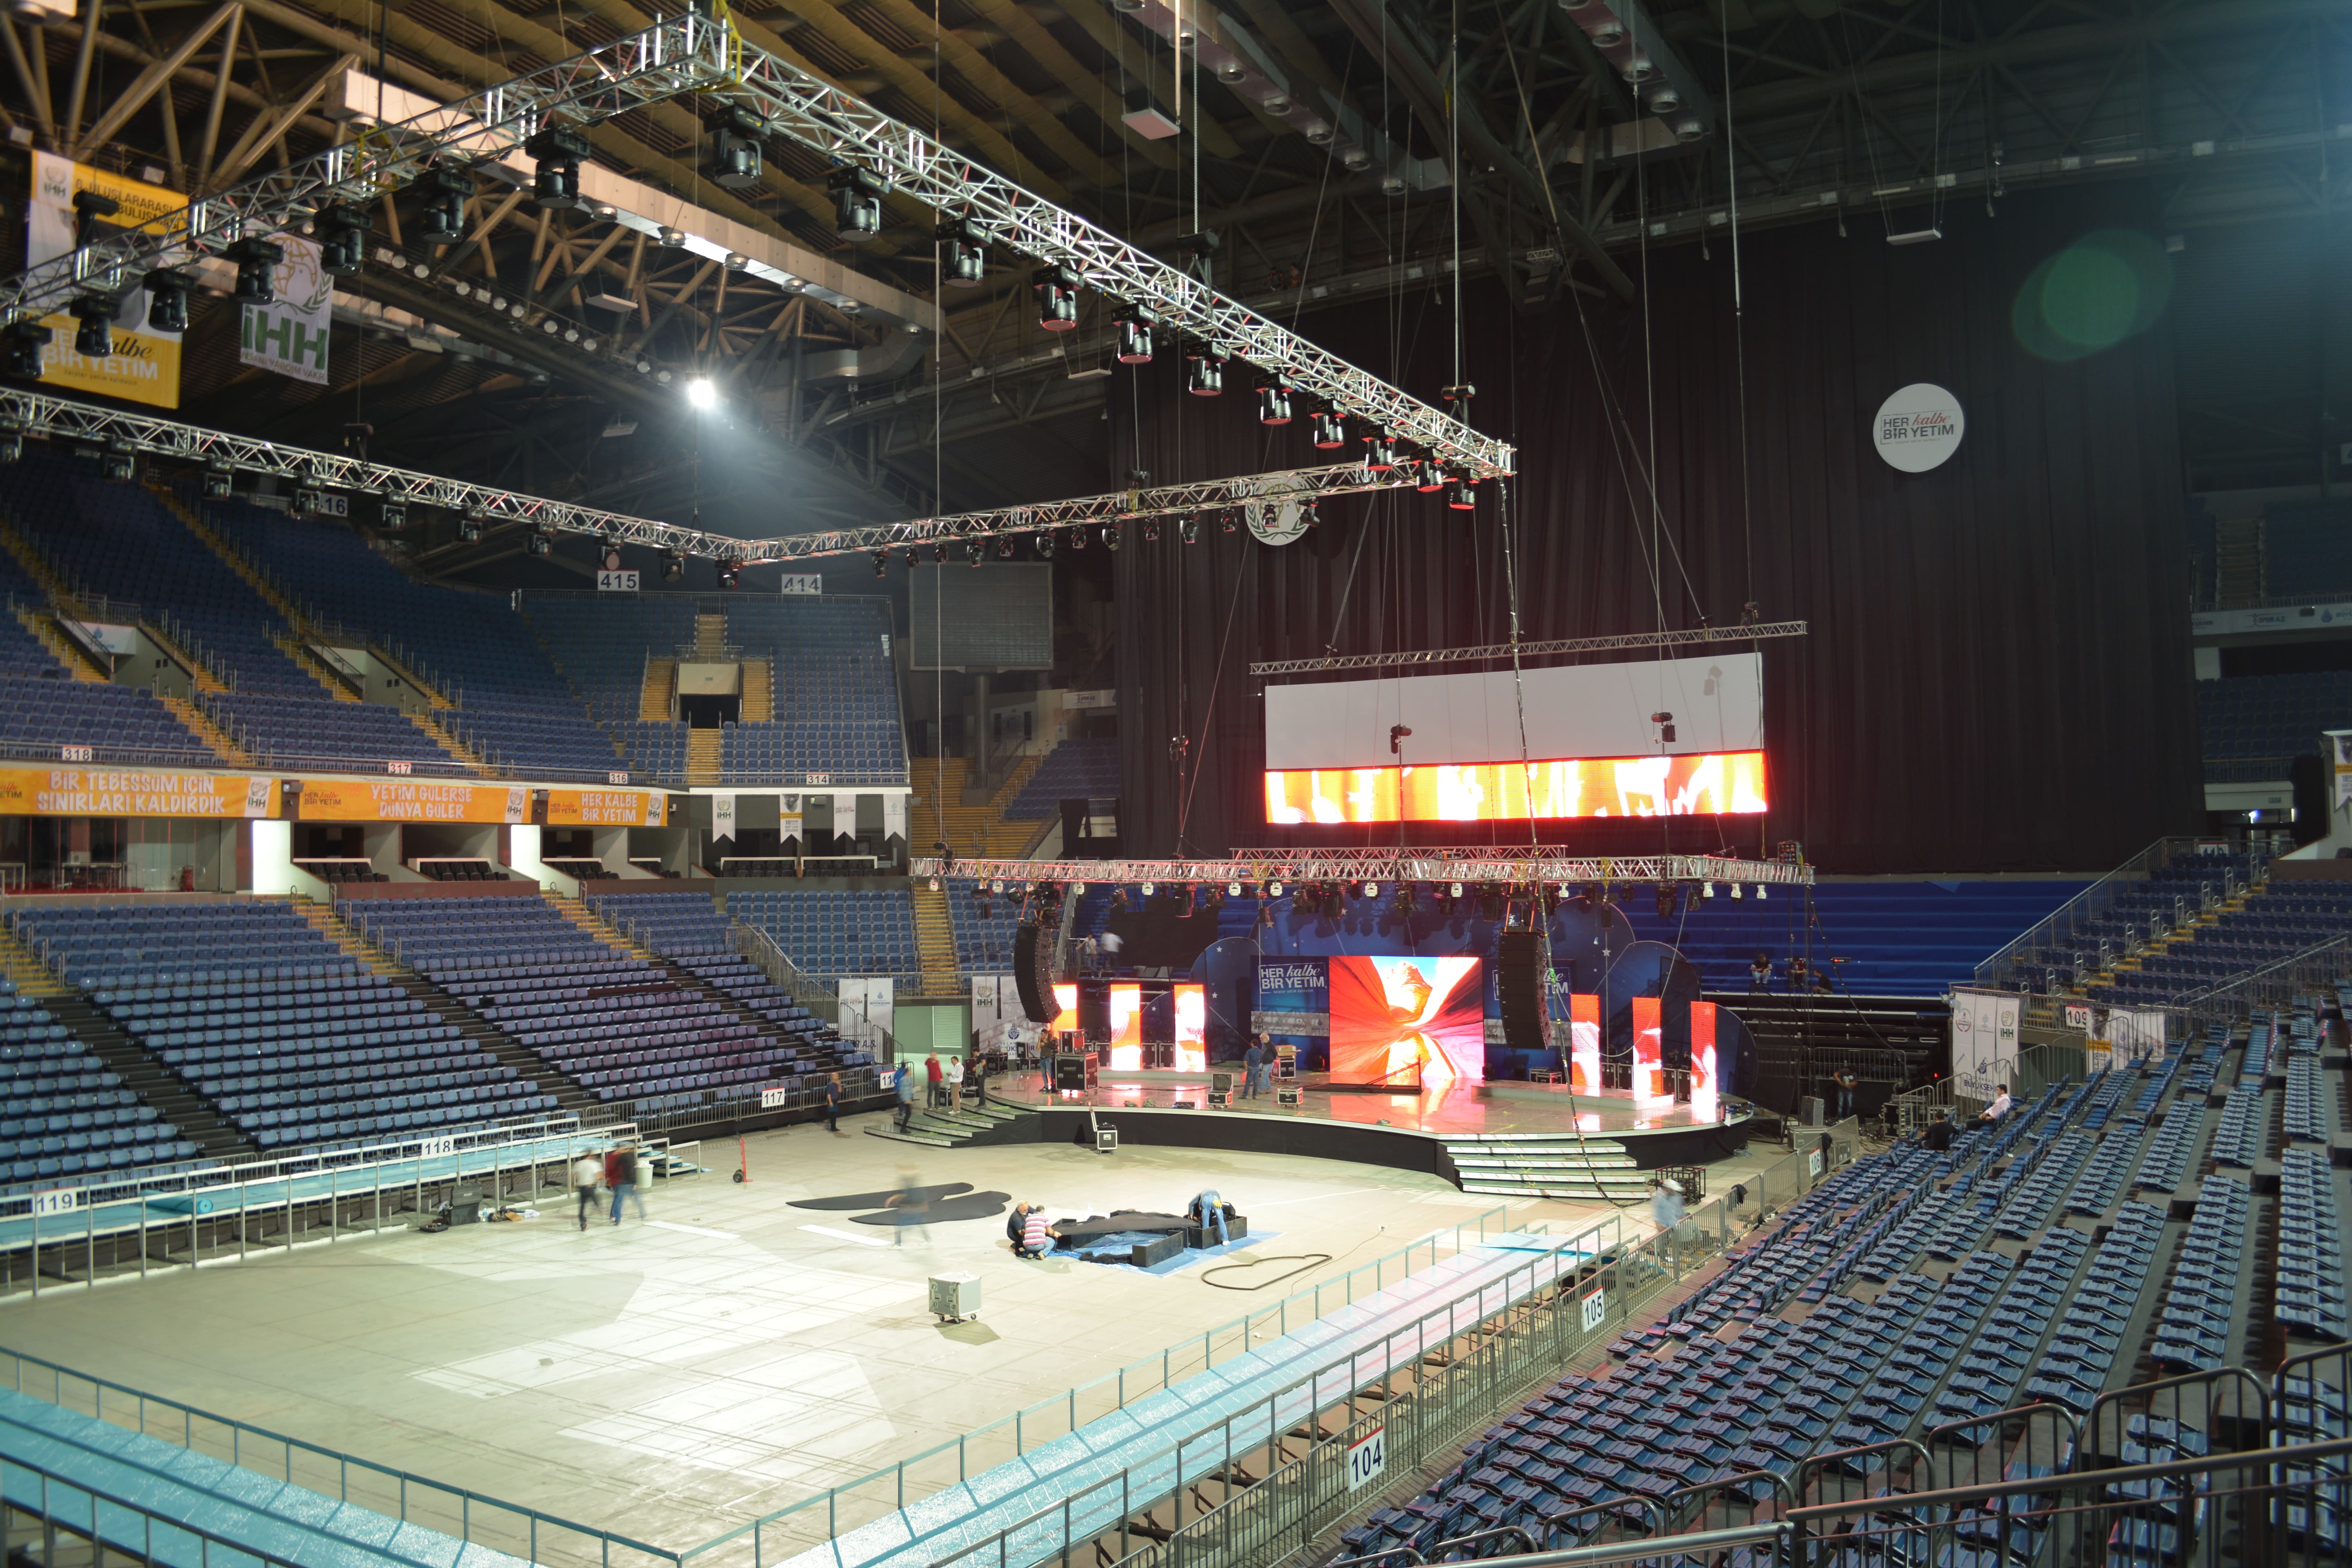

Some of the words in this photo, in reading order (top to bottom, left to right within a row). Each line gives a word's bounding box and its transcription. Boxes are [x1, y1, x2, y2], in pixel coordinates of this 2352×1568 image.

[1883, 417, 1909, 428] HER
[1912, 412, 1951, 426] kalbe
[325, 497, 345, 514] 16
[600, 573, 637, 589] 415
[784, 577, 820, 592] 414
[65, 748, 90, 760] 318
[390, 763, 410, 774] 317
[85, 772, 179, 793] TEBESSÜM
[610, 773, 626, 783] 316
[808, 775, 828, 784] 314
[419, 785, 472, 803] GÜLERSE
[581, 792, 603, 807] HER
[604, 793, 638, 808] KALBE
[37, 791, 131, 812] SINIRLARI
[135, 794, 226, 814] KALDIRDIK
[379, 802, 423, 818] DÜNYA
[425, 803, 465, 819] GÜLER
[1260, 968, 1284, 978] HER
[1285, 964, 1321, 977] kalbe
[2067, 1010, 2087, 1025] 109
[1964, 1079, 1997, 1093] BÜYÜKŞEHİ
[764, 1091, 783, 1105] 117
[425, 1140, 450, 1155] 118
[1811, 1153, 1820, 1172] 106
[38, 1193, 73, 1212] 119
[1585, 1294, 1602, 1326] 105
[1352, 1437, 1382, 1483] 104
